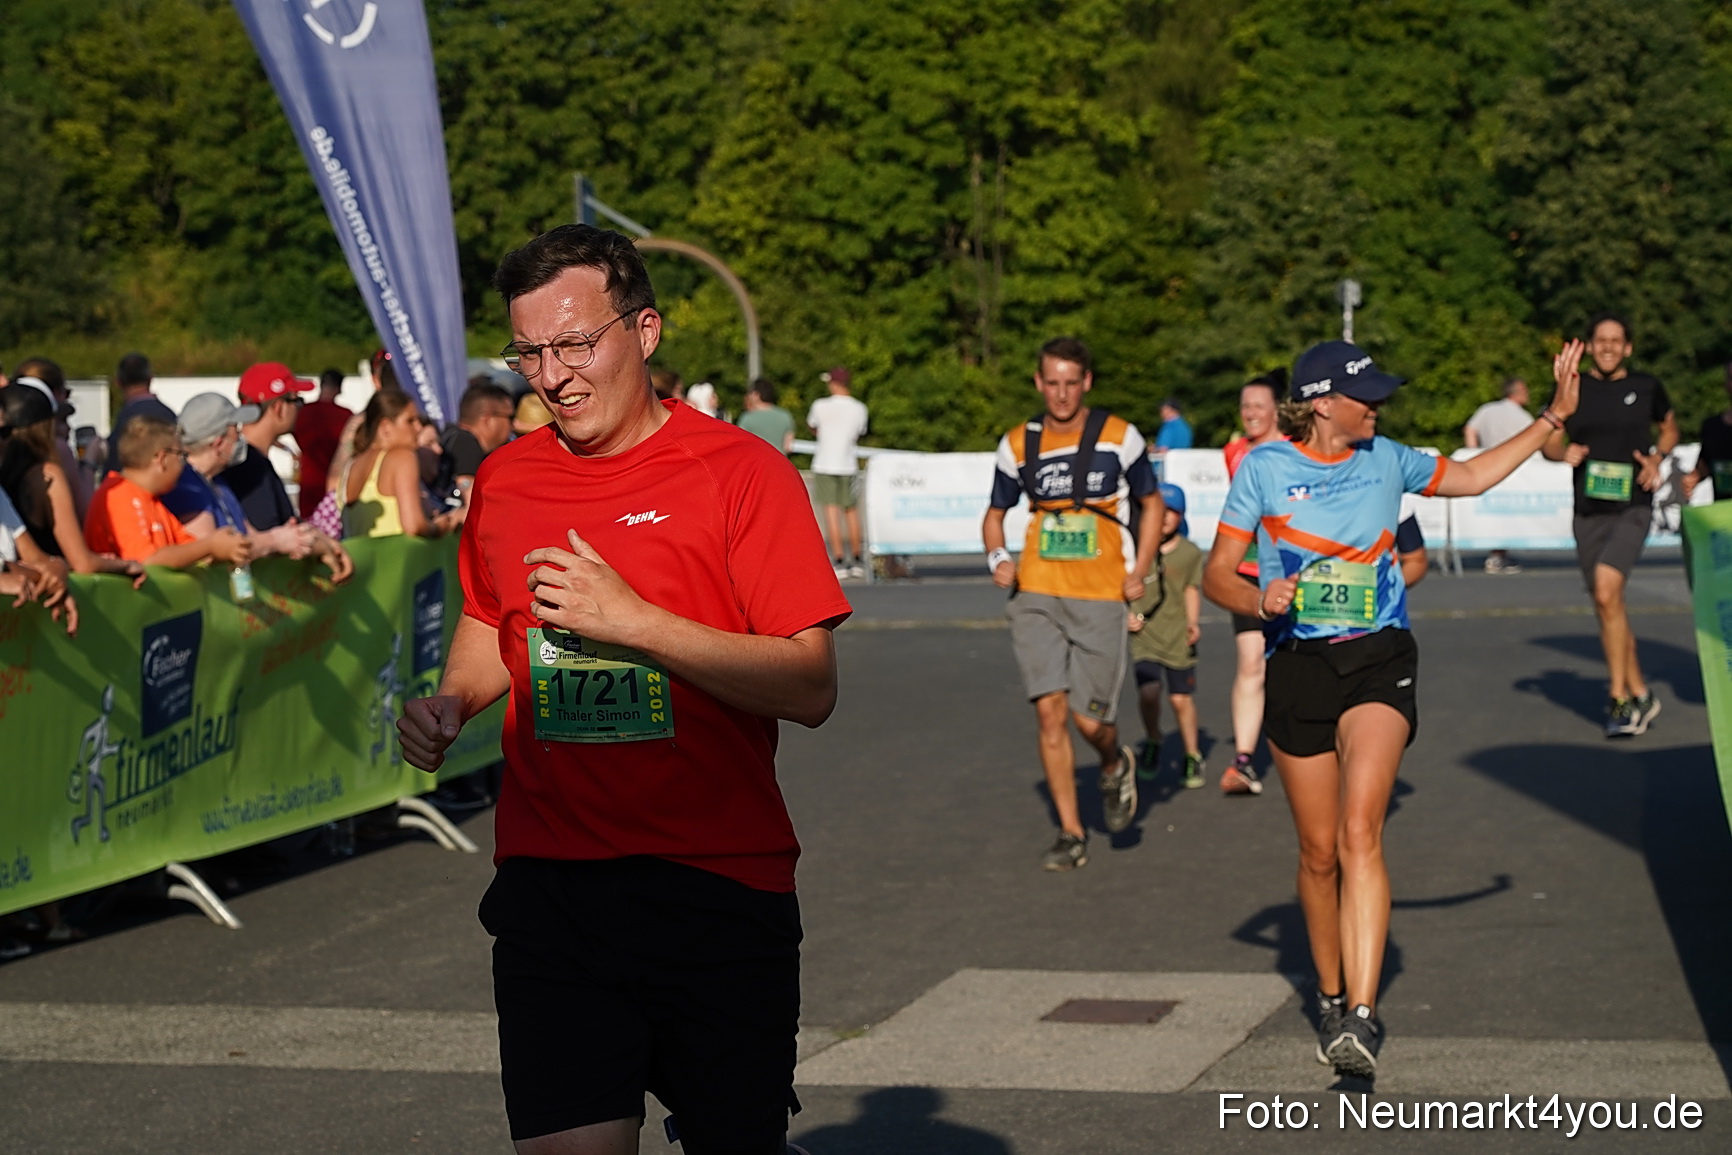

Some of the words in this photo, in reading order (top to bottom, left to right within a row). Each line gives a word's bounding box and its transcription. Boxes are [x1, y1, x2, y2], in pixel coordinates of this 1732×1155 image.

[627, 509, 656, 526] DEHN
[1320, 583, 1349, 604] 28
[558, 651, 598, 660] Firmenlauf
[538, 679, 550, 718] RUN
[551, 668, 639, 706] 1721
[647, 671, 665, 723] 2022
[556, 708, 593, 721] Thaler
[596, 710, 641, 721] Simon
[116, 687, 244, 803] firmenlauf
